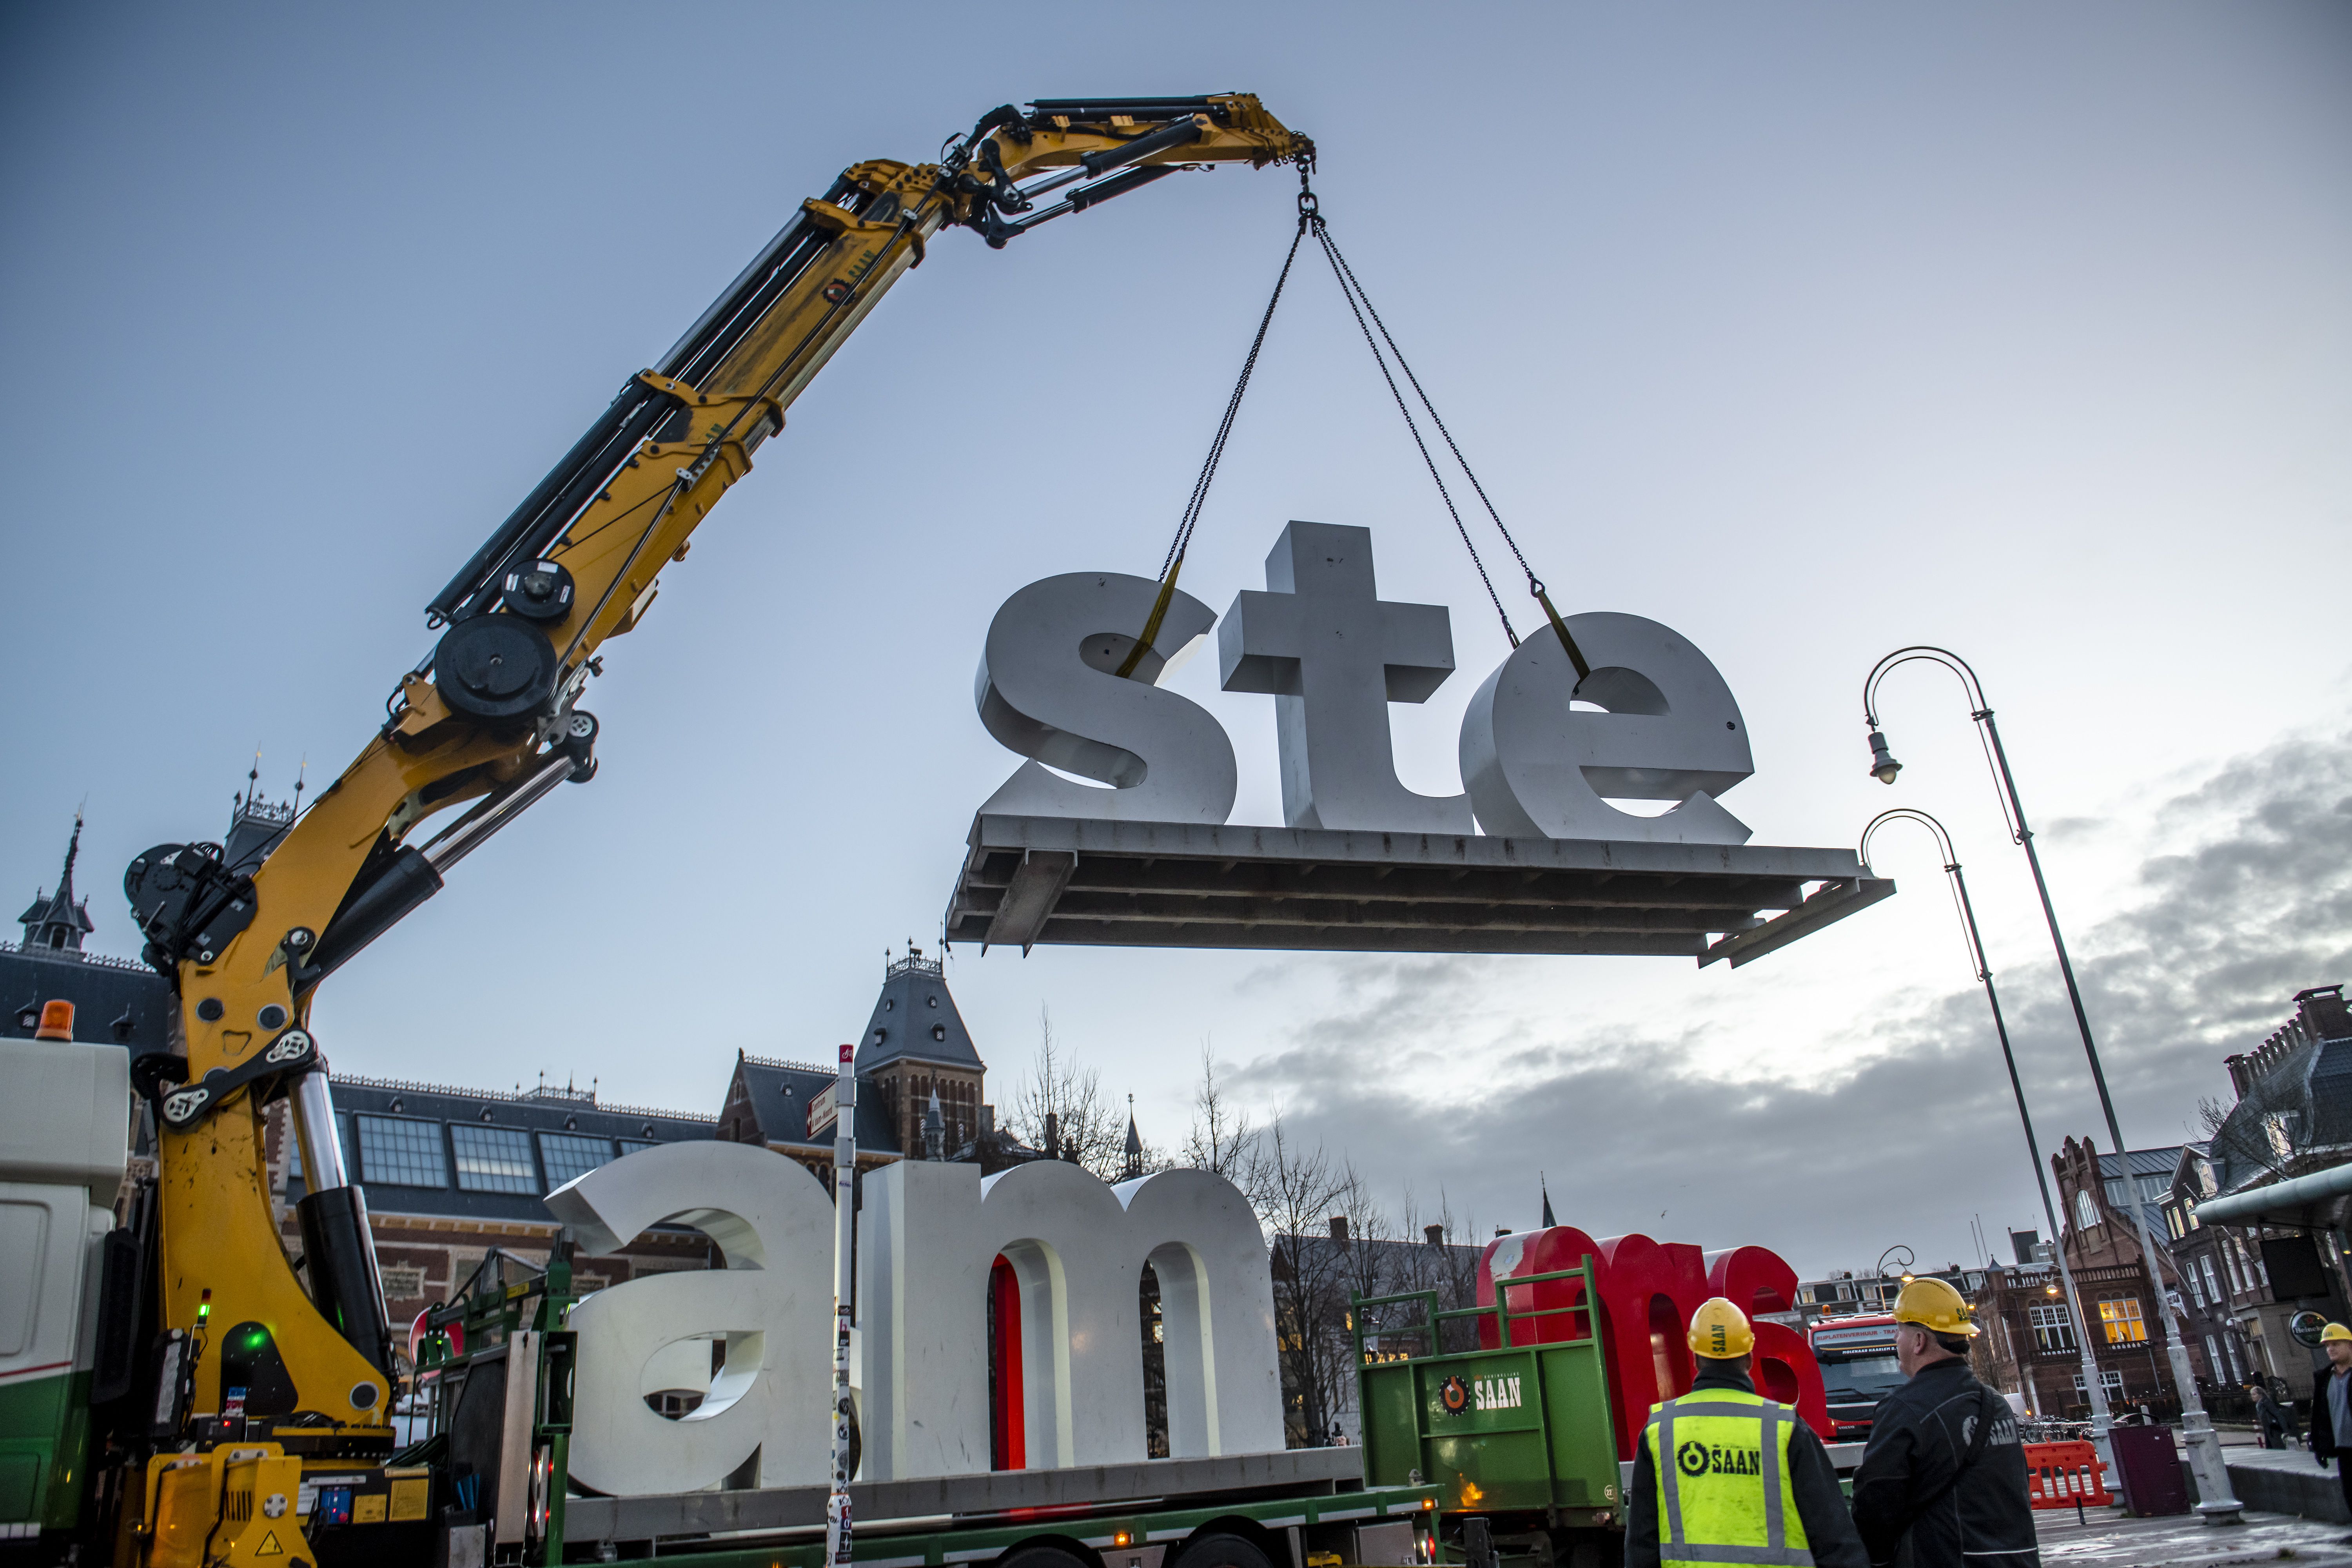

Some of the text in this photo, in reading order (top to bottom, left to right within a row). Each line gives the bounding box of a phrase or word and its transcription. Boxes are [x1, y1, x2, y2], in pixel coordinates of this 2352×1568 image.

[975, 520, 1755, 845] ste
[544, 1140, 1286, 1497] am
[1711, 1324, 1726, 1352] SAAN
[1817, 1330, 1878, 1341] RIJPLATENVERHUUR
[1474, 1377, 1521, 1410] SAAN
[1990, 1419, 2018, 1445] SAAN
[1712, 1449, 1760, 1475] SAAN
